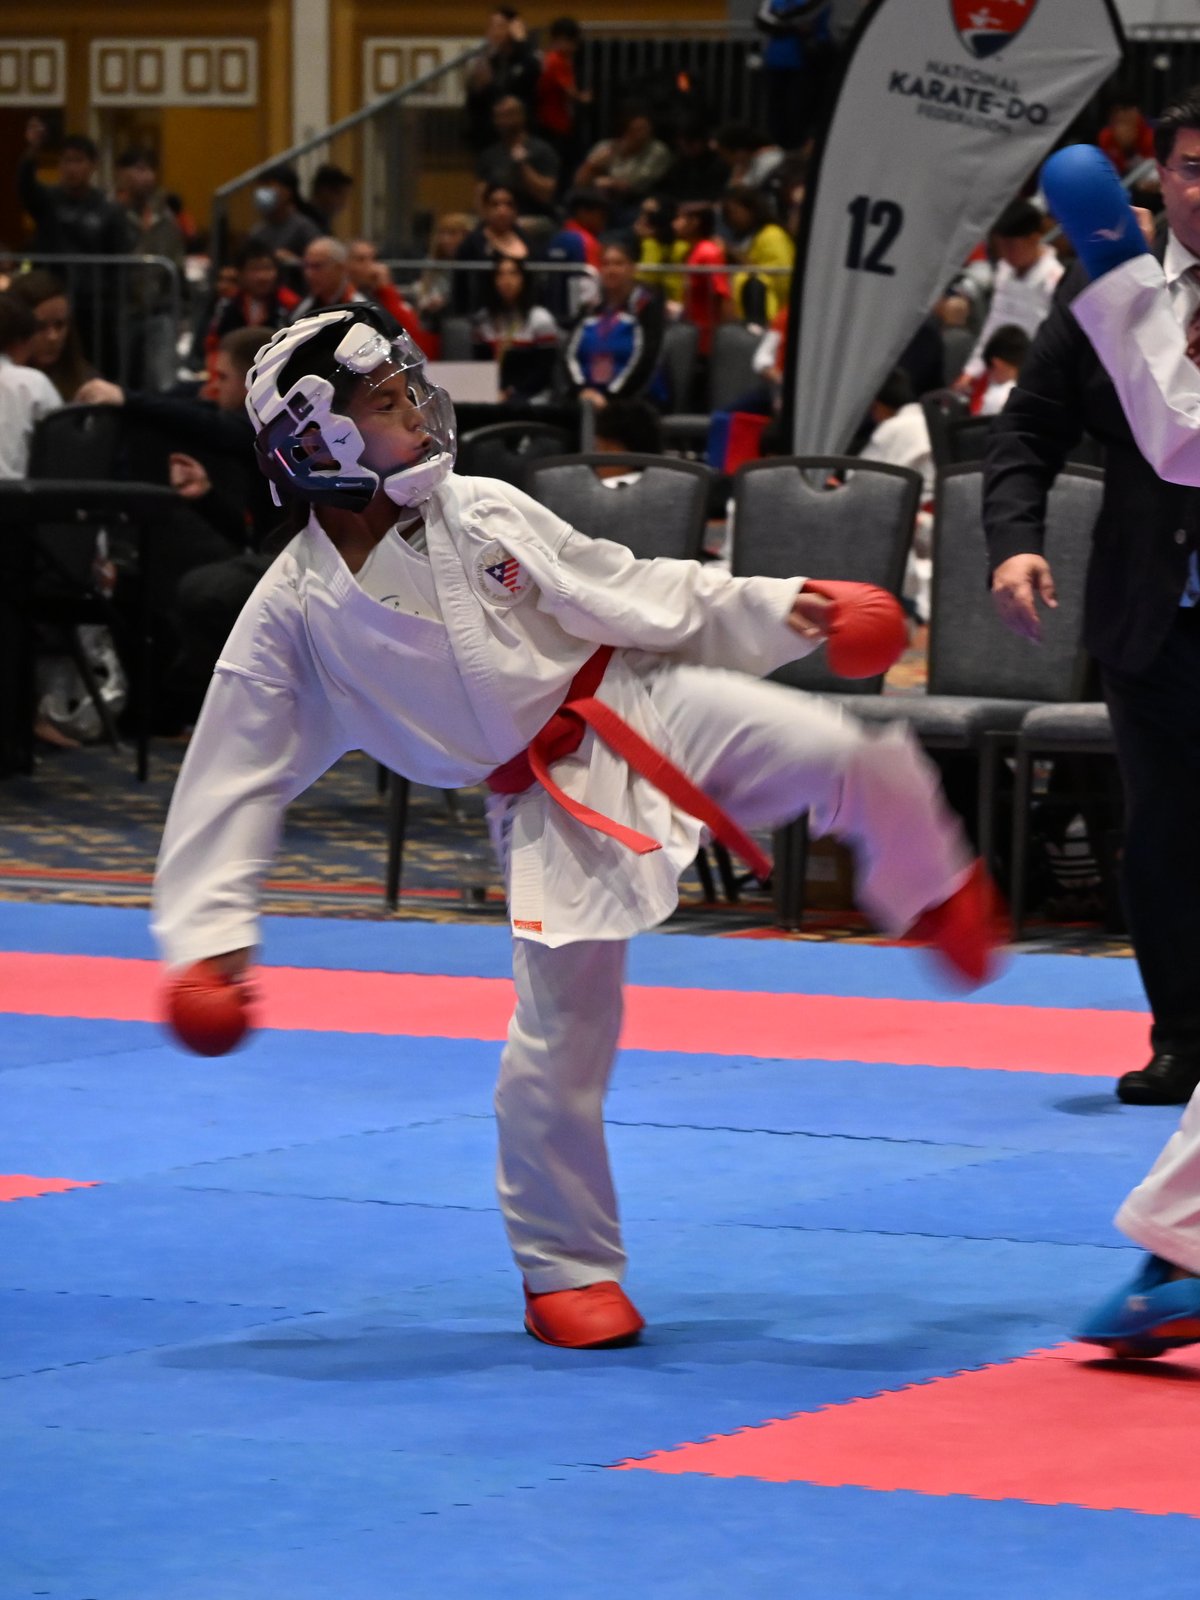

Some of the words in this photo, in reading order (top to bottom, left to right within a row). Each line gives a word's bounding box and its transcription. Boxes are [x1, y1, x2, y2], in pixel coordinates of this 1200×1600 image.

[888, 70, 1049, 126] KARATE-DO
[926, 60, 1020, 95] NATIONAL
[845, 195, 904, 277] 12
